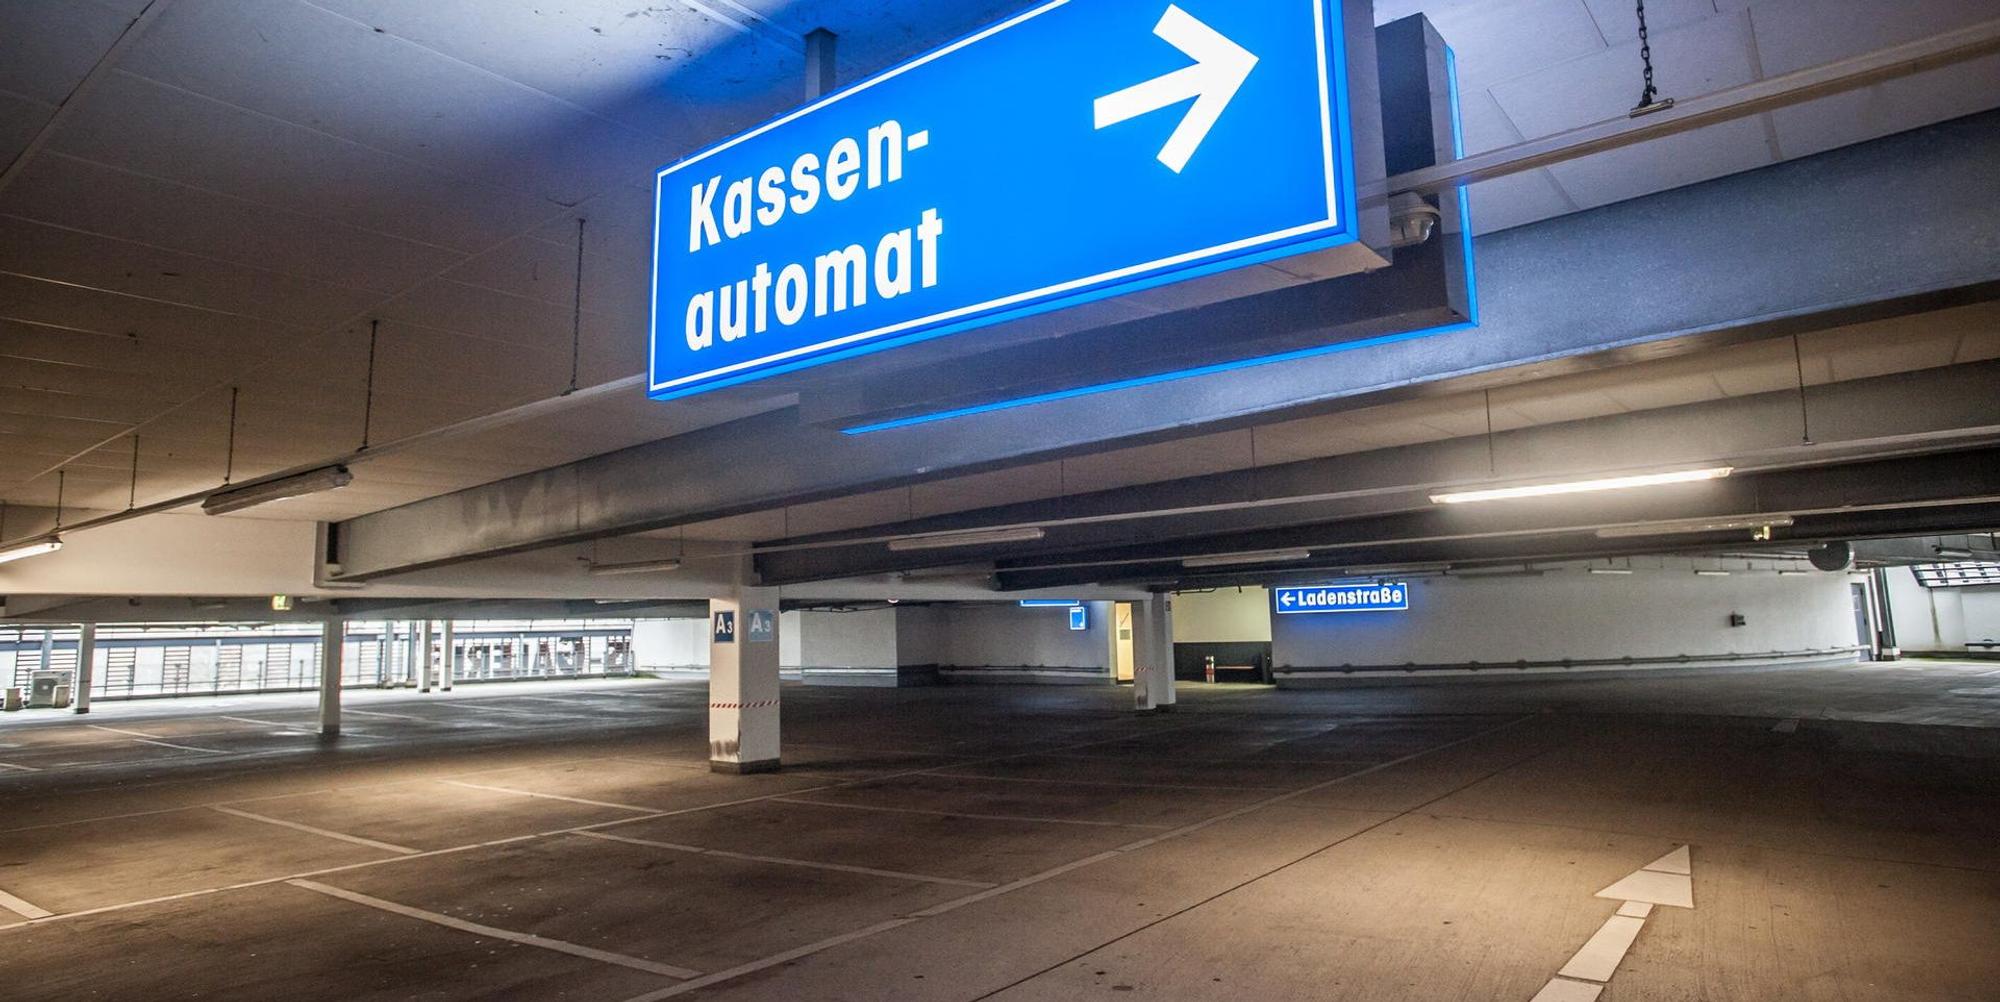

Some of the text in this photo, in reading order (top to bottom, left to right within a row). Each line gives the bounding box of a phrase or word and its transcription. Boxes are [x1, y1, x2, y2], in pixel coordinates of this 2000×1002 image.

[689, 119, 929, 253] Kassen-
[685, 207, 943, 351] automat
[1298, 587, 1402, 607] Ladenstraße
